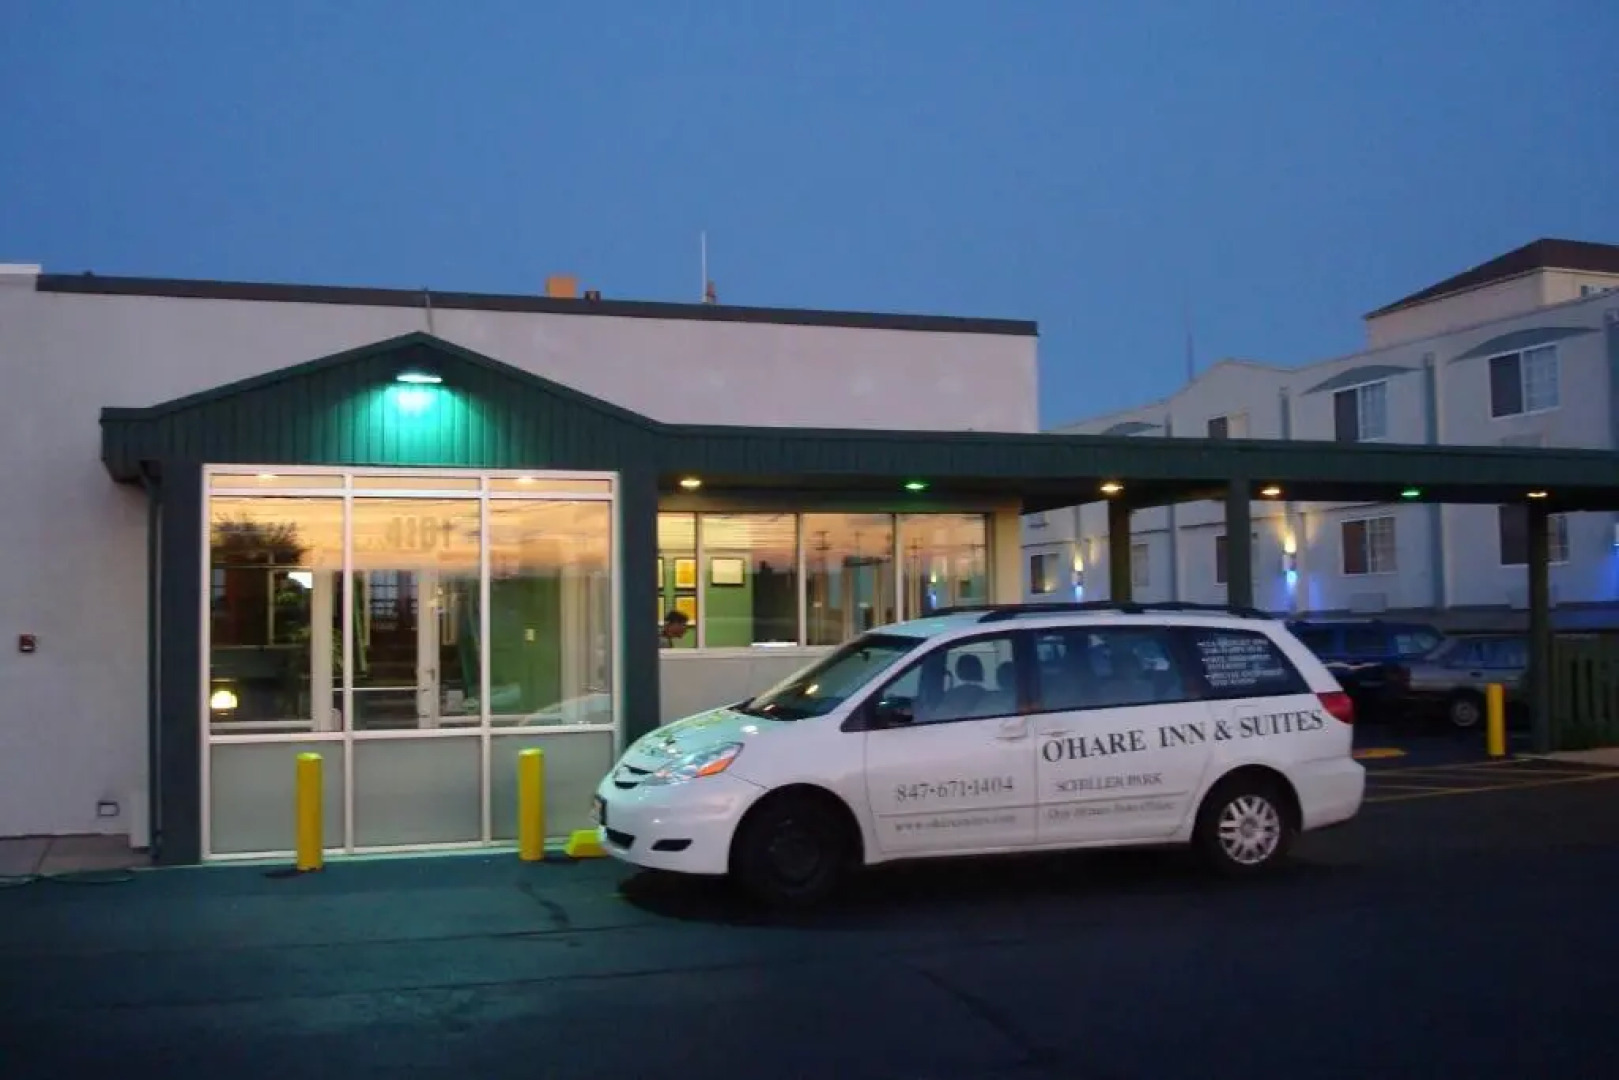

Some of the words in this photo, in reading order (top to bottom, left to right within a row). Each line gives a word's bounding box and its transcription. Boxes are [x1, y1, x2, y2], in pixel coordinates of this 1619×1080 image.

[1042, 729, 1147, 763] O'HARE
[1158, 721, 1206, 748] INN
[1213, 719, 1233, 742] &
[1239, 709, 1325, 738] SUITES
